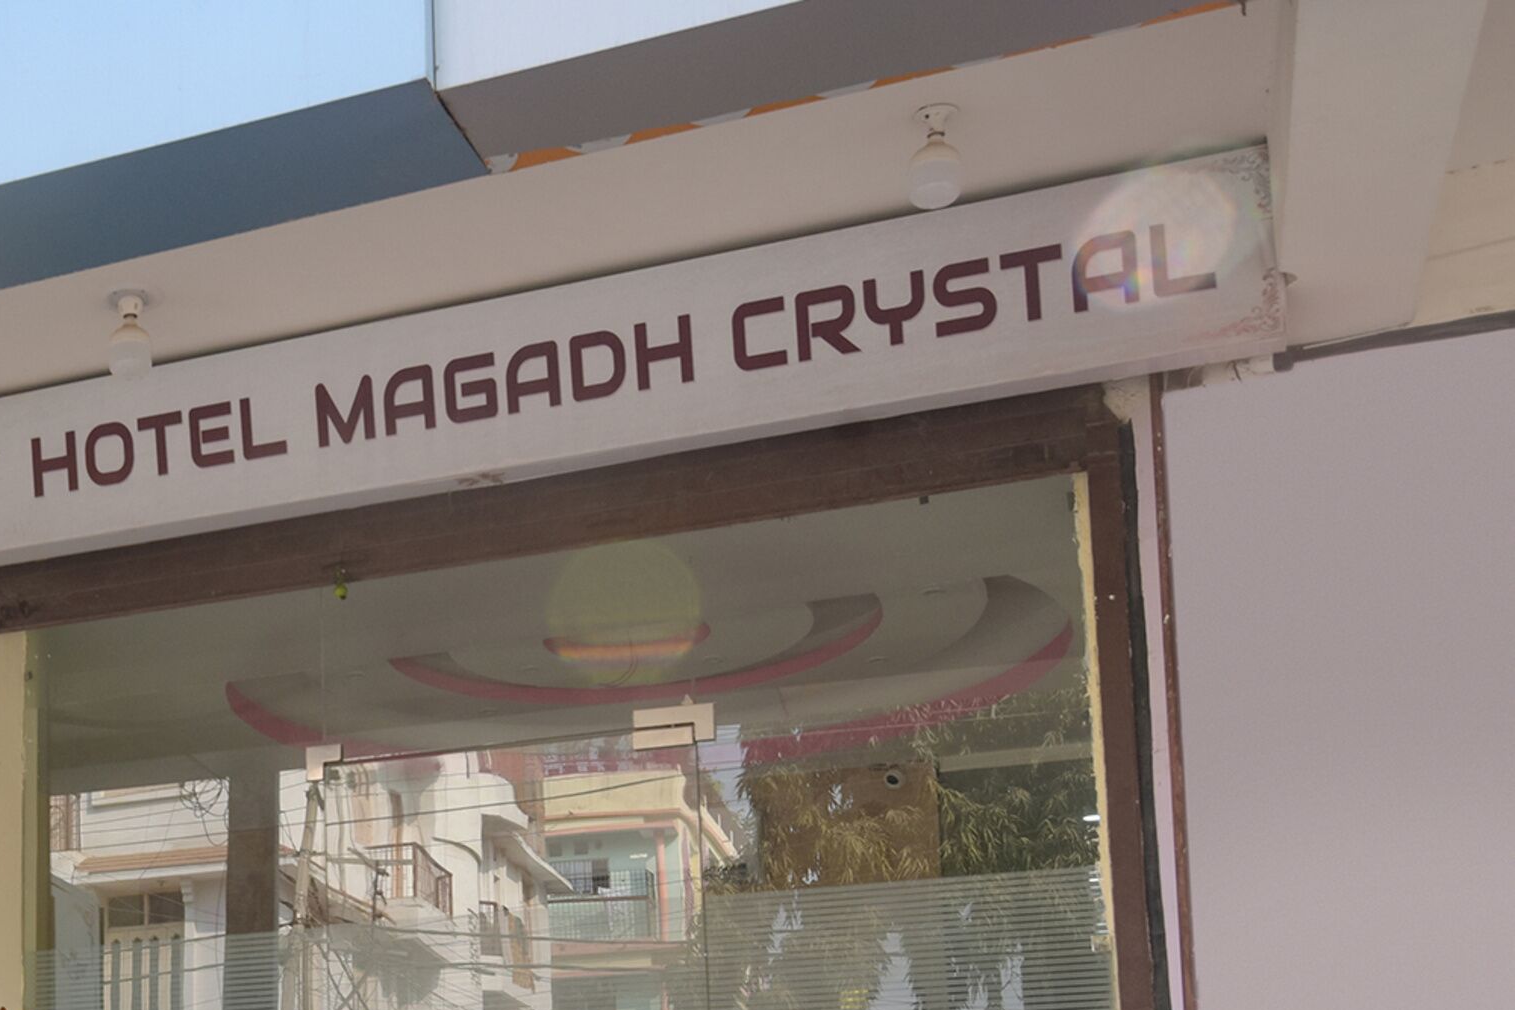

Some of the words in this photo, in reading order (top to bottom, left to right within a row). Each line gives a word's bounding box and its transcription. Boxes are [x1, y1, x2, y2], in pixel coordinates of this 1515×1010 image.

[29, 398, 289, 498] HOTEL
[314, 313, 696, 449] MAGADH
[731, 223, 1219, 373] CRYSTAL
